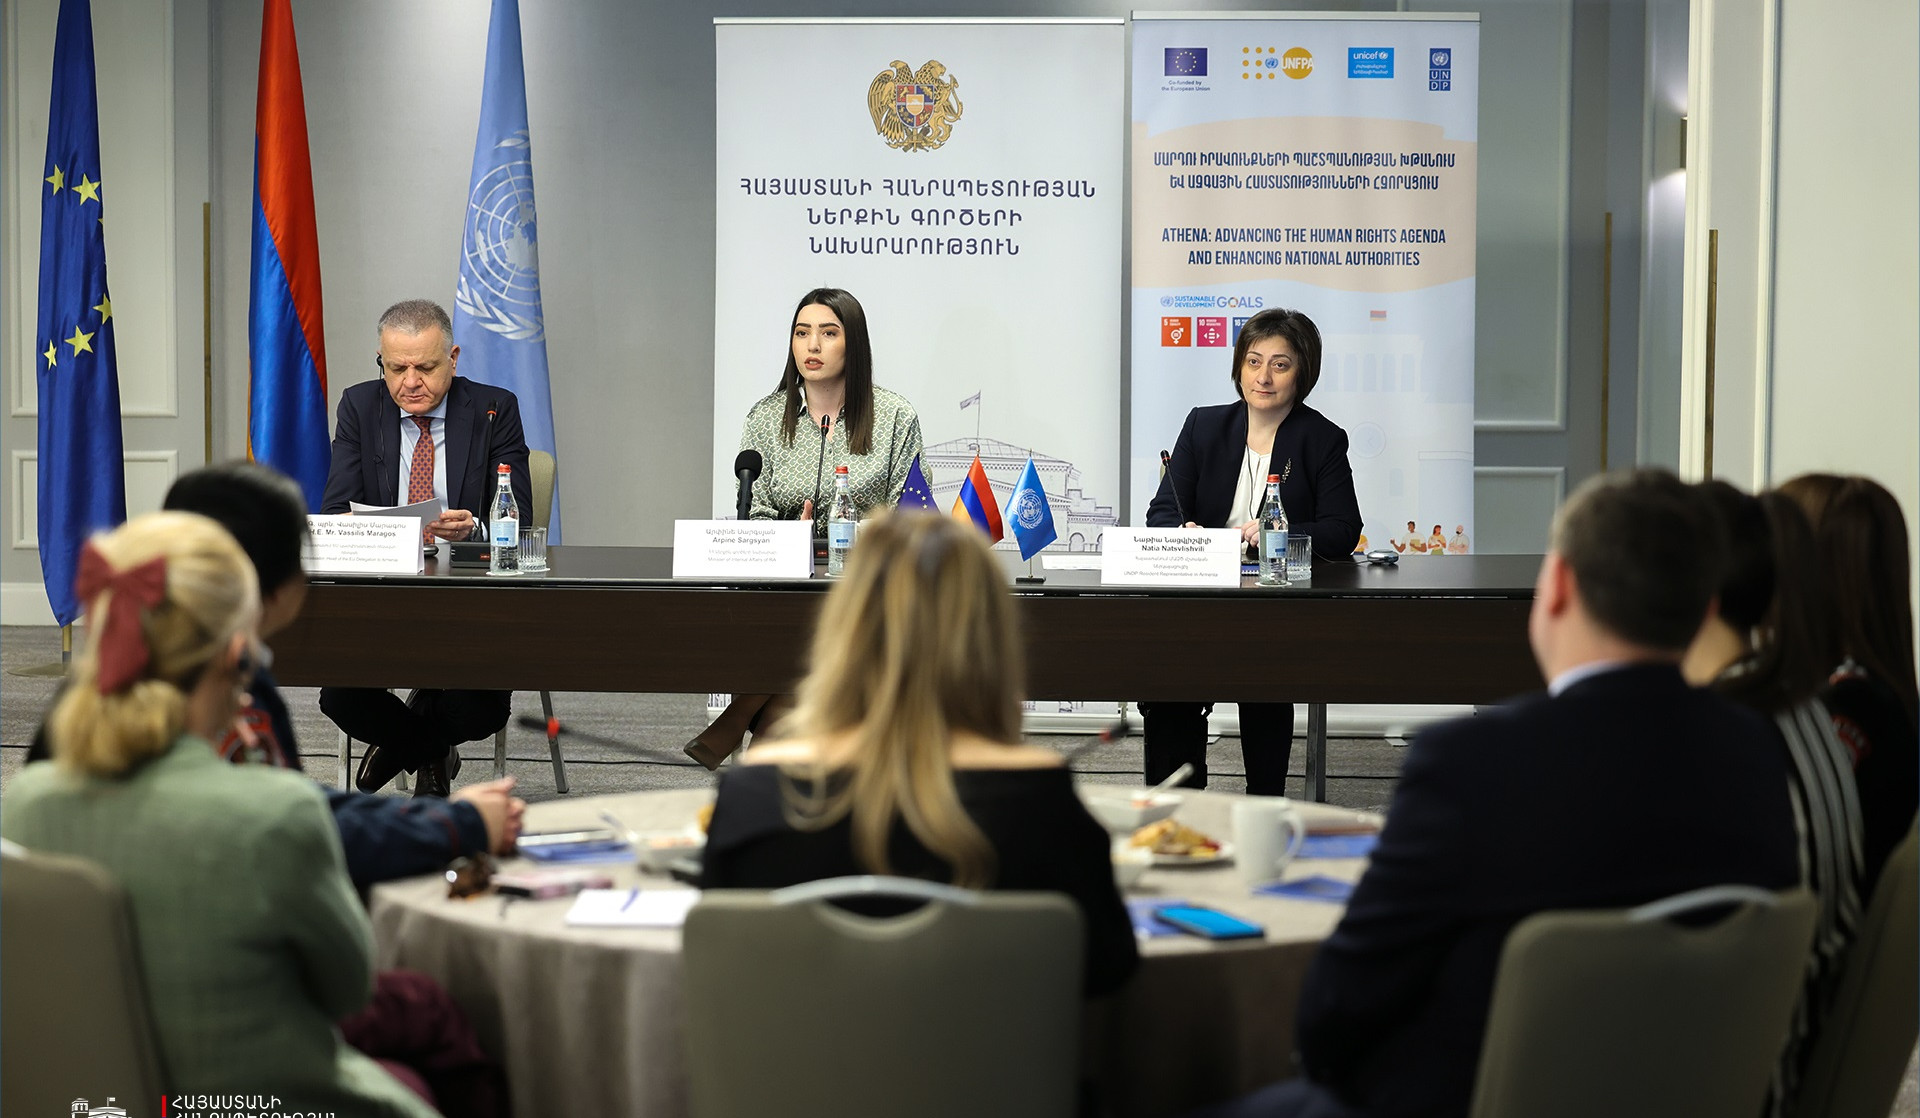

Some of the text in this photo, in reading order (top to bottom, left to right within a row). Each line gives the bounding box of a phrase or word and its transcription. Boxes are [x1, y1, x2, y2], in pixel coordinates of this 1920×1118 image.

[1353, 50, 1379, 60] unicef
[1282, 57, 1314, 70] UNFPA
[1154, 152, 1456, 167] ՄԱՐԴՈՒ ԻՐԱՎՈՒՆՔՆԵՐԻ ՊԱՇՏՊԱՆՈՒԹՅԱՆ ԽԹԱՆՈՒՄ
[740, 178, 1096, 198] ՀԱՅԱՍՏԱՆԻ ՀԱՆՐԱՊԵՏՈՒԹՅԱՆ
[1170, 174, 1439, 190] ԵՎ ԱԶԳԱՅԻՆ ՀԱՍՏԱՏՈՒԹՅՈՒՆՆԵՐԻ ՀԶՈՐԱՑՈՒՄ
[807, 207, 1023, 227] ՆԵՐՔԻՆ ԳՈՐԾԵՐԻ
[1162, 228, 1446, 243] ATHENA: ADVANCING THE HUMAN RIGHTS AGENDA
[809, 237, 1020, 256] ՆԱԽԱՐԱՐՈՒԹՅՈՒՆ
[1188, 251, 1420, 266] AND ENHANCING NATIONAL AUTHORITIES
[1217, 296, 1263, 309] GOALS
[1163, 319, 1169, 327] 5
[1198, 319, 1206, 327] 10
[338, 529, 365, 537] Vassilis
[367, 530, 396, 538] Maragos
[738, 537, 770, 545] Sargsyan
[1133, 536, 1212, 545] Նաթիա Նացվլիշվիլի
